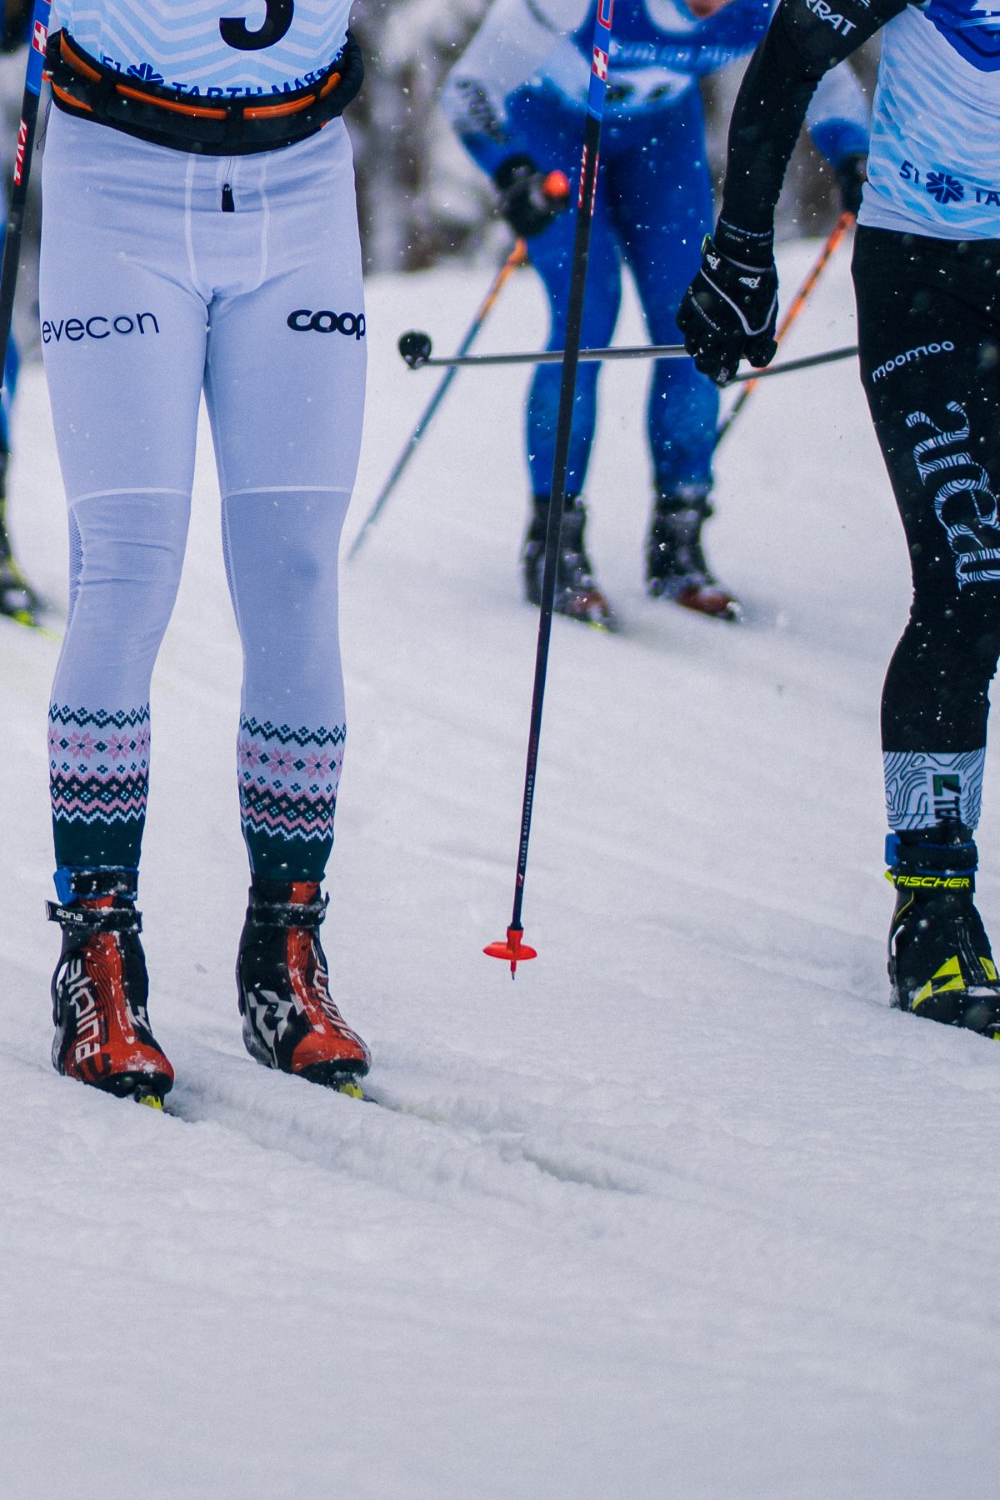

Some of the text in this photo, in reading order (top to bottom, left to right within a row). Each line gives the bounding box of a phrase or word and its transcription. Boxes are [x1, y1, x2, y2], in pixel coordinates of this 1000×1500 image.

[899, 160, 920, 184] 51
[42, 312, 160, 344] evecon
[286, 309, 366, 340] coop
[872, 340, 956, 383] moomoo
[897, 875, 970, 889] FISCHER
